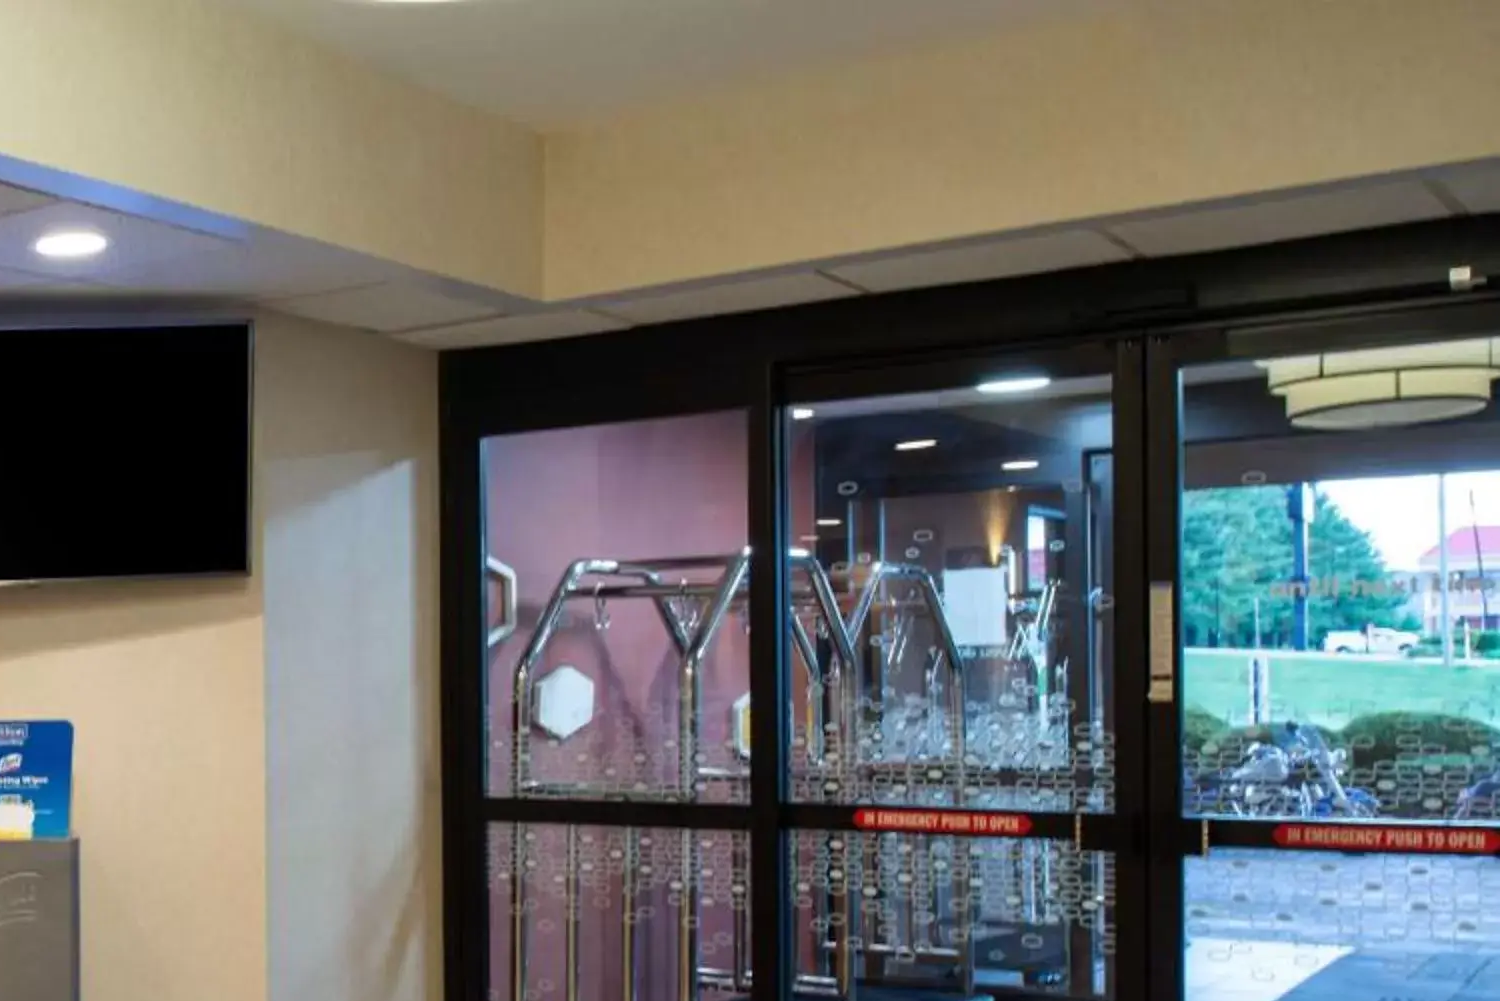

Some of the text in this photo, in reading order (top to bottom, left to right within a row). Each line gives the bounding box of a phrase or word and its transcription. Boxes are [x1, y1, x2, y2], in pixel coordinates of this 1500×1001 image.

[863, 811, 1019, 832] IN EMERGENCY PUSH TO OPEN
[1287, 827, 1486, 850] IN EMERGENCY PUSH TO OPEN
